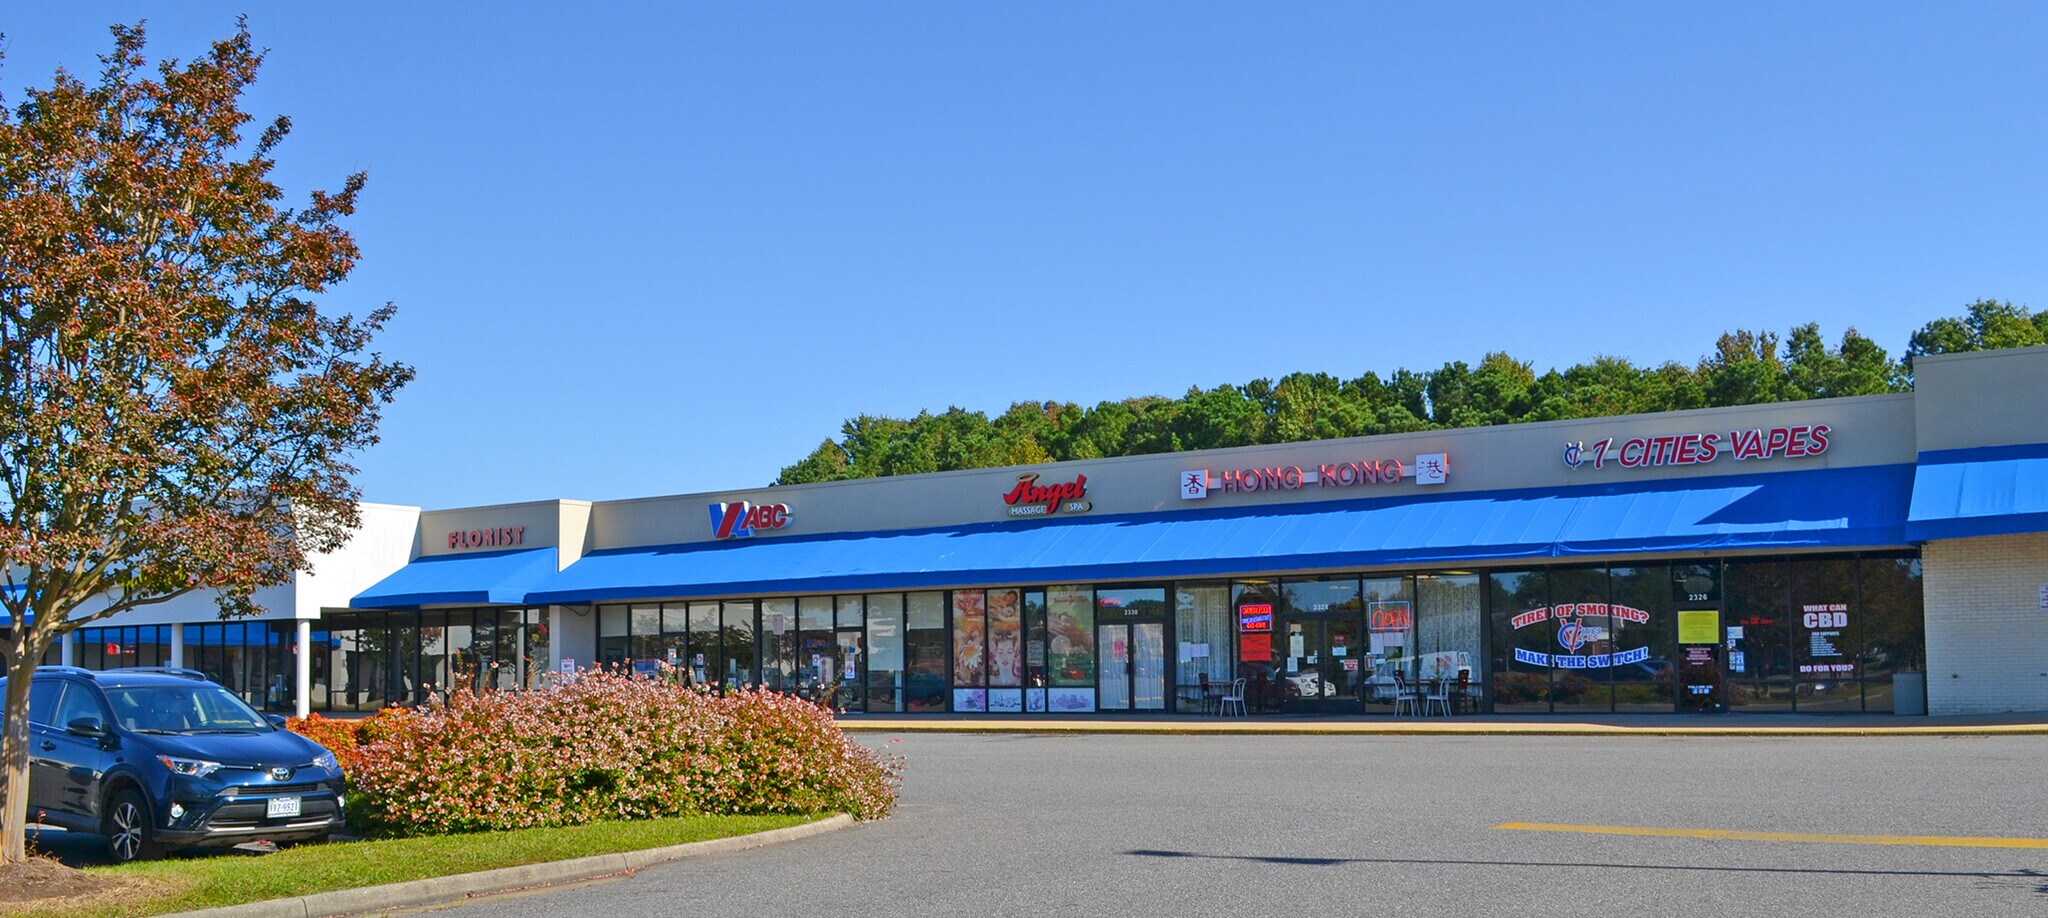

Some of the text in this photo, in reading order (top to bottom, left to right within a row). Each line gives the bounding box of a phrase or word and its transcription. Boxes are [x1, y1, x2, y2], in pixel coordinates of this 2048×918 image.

[1592, 438, 1612, 469] 7
[1618, 433, 1720, 467] CITIES
[1730, 425, 1831, 460] VAPES
[1220, 460, 1402, 493] HONG KONG
[1418, 460, 1443, 479] 港
[1003, 473, 1087, 514] Angel
[1184, 473, 1204, 494] 香
[739, 503, 793, 529] ABC
[1011, 501, 1084, 515] MASSAGE SPA
[448, 527, 524, 549] FLORIST
[1688, 593, 1708, 601] 2326
[1803, 603, 1847, 612] WHAT CAN
[1512, 606, 1554, 630] TIRED
[1555, 603, 1575, 618] OF
[1803, 612, 1848, 628] CBD
[1556, 655, 1586, 668] THE
[1588, 646, 1648, 668] SWTCH!
[1830, 664, 1854, 672] YOU?
